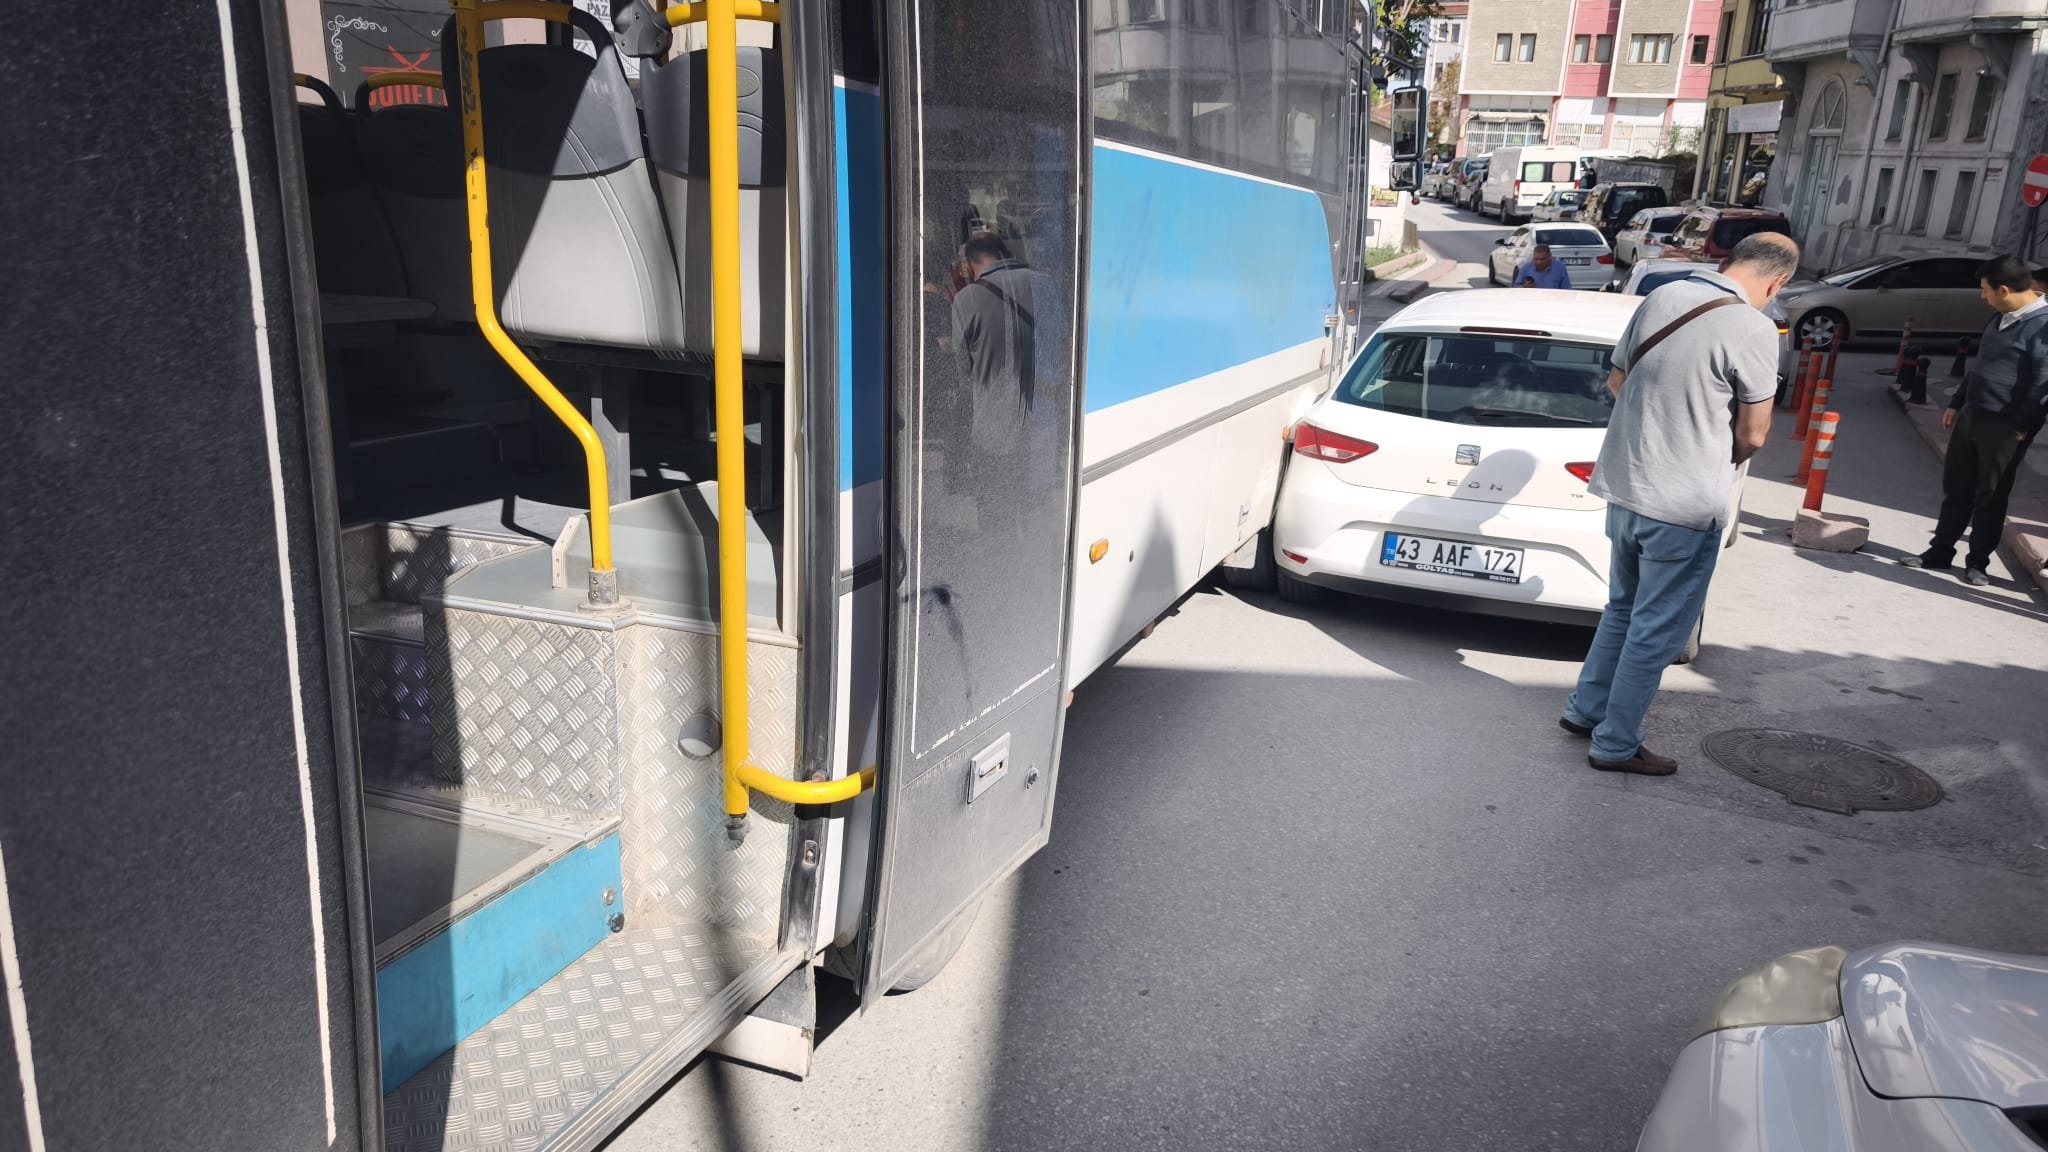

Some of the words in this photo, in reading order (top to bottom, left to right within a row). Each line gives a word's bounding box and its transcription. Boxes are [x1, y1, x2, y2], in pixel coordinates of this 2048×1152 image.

[1426, 476, 1503, 492] LEON
[1396, 538, 1421, 560] 43
[1432, 543, 1473, 567] AAF
[1484, 549, 1517, 574] 172
